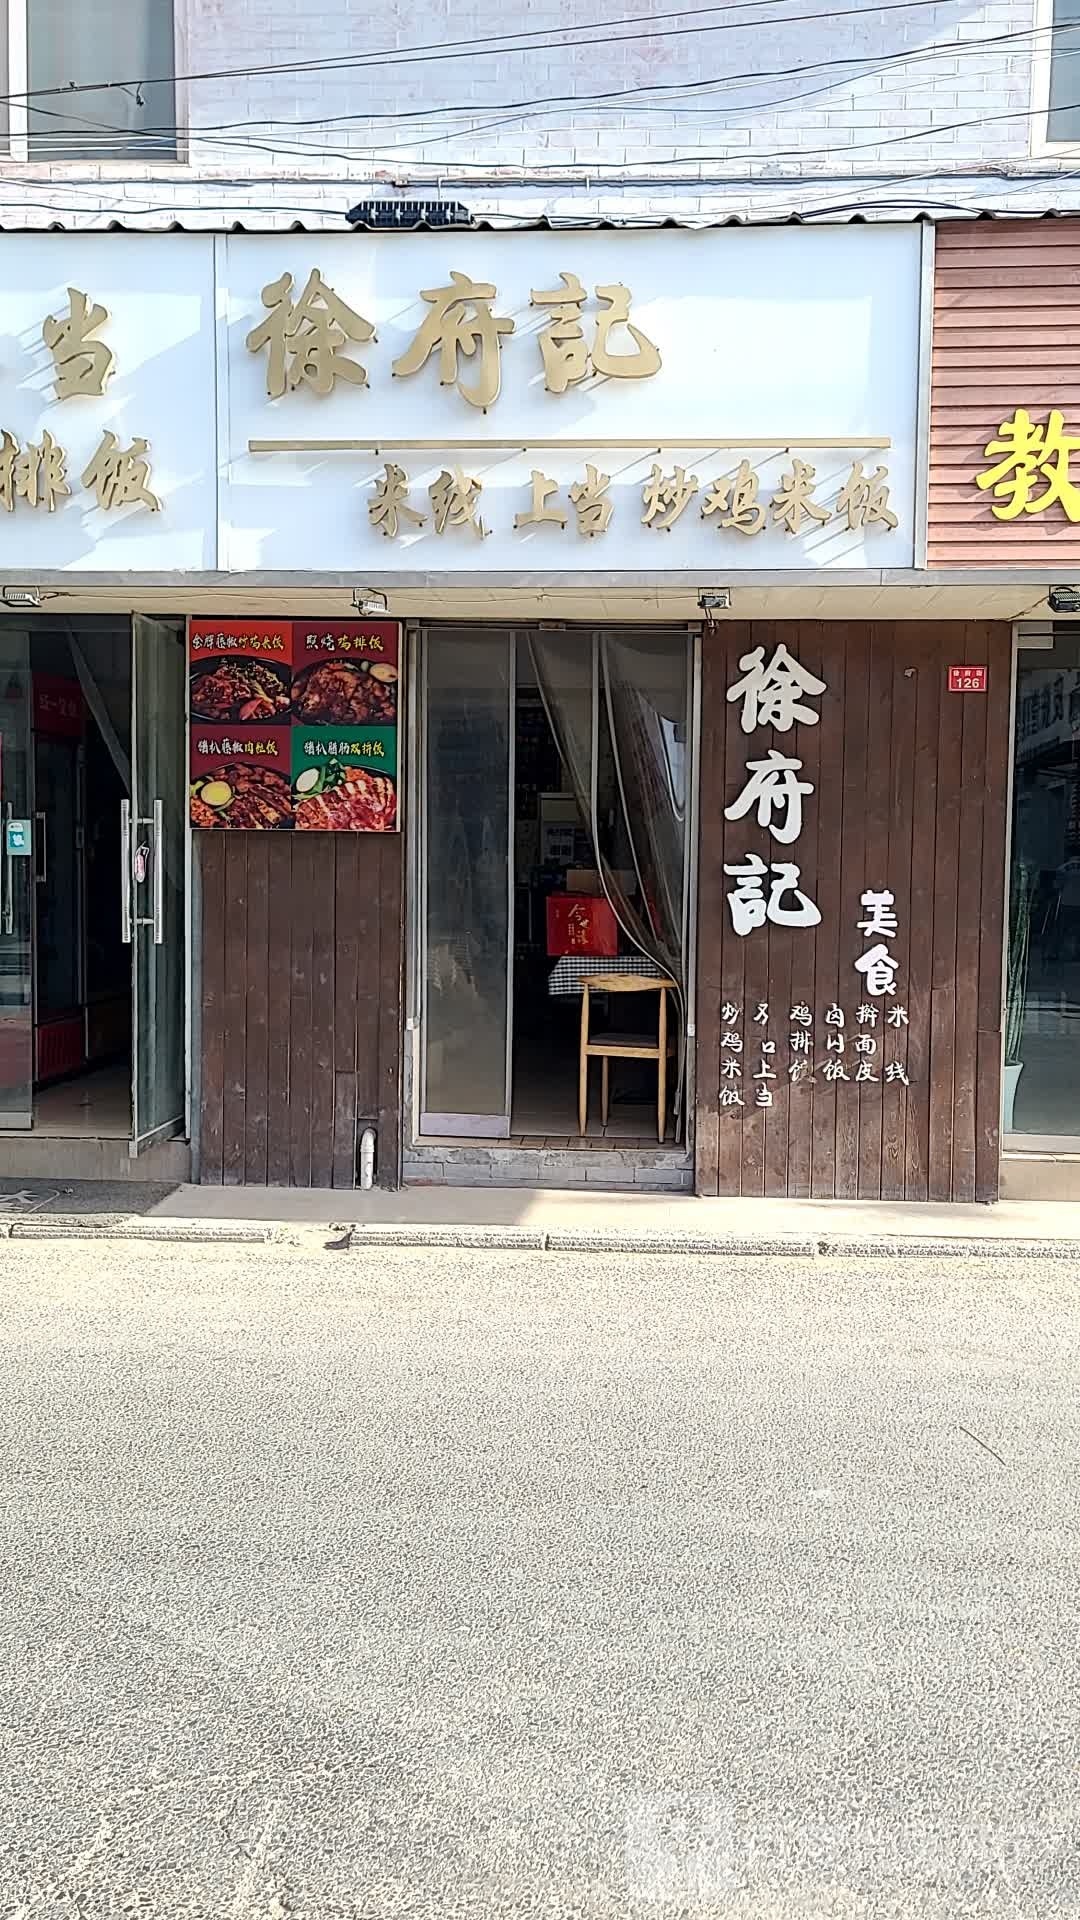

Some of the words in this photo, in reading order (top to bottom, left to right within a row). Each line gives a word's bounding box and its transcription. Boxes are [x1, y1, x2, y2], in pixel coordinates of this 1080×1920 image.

[43, 287, 115, 400] 当
[248, 268, 662, 409] 徐府記
[640, 459, 898, 535] 炒鸡米饭
[976, 408, 1080, 522] 教
[305, 633, 385, 652] 照烧鸡排饭
[956, 678, 980, 688] 126
[724, 643, 827, 936] 徐府記
[854, 888, 900, 997] 美食
[718, 1001, 745, 1107] 炒鸡米饭
[884, 1003, 910, 1086] 米线
